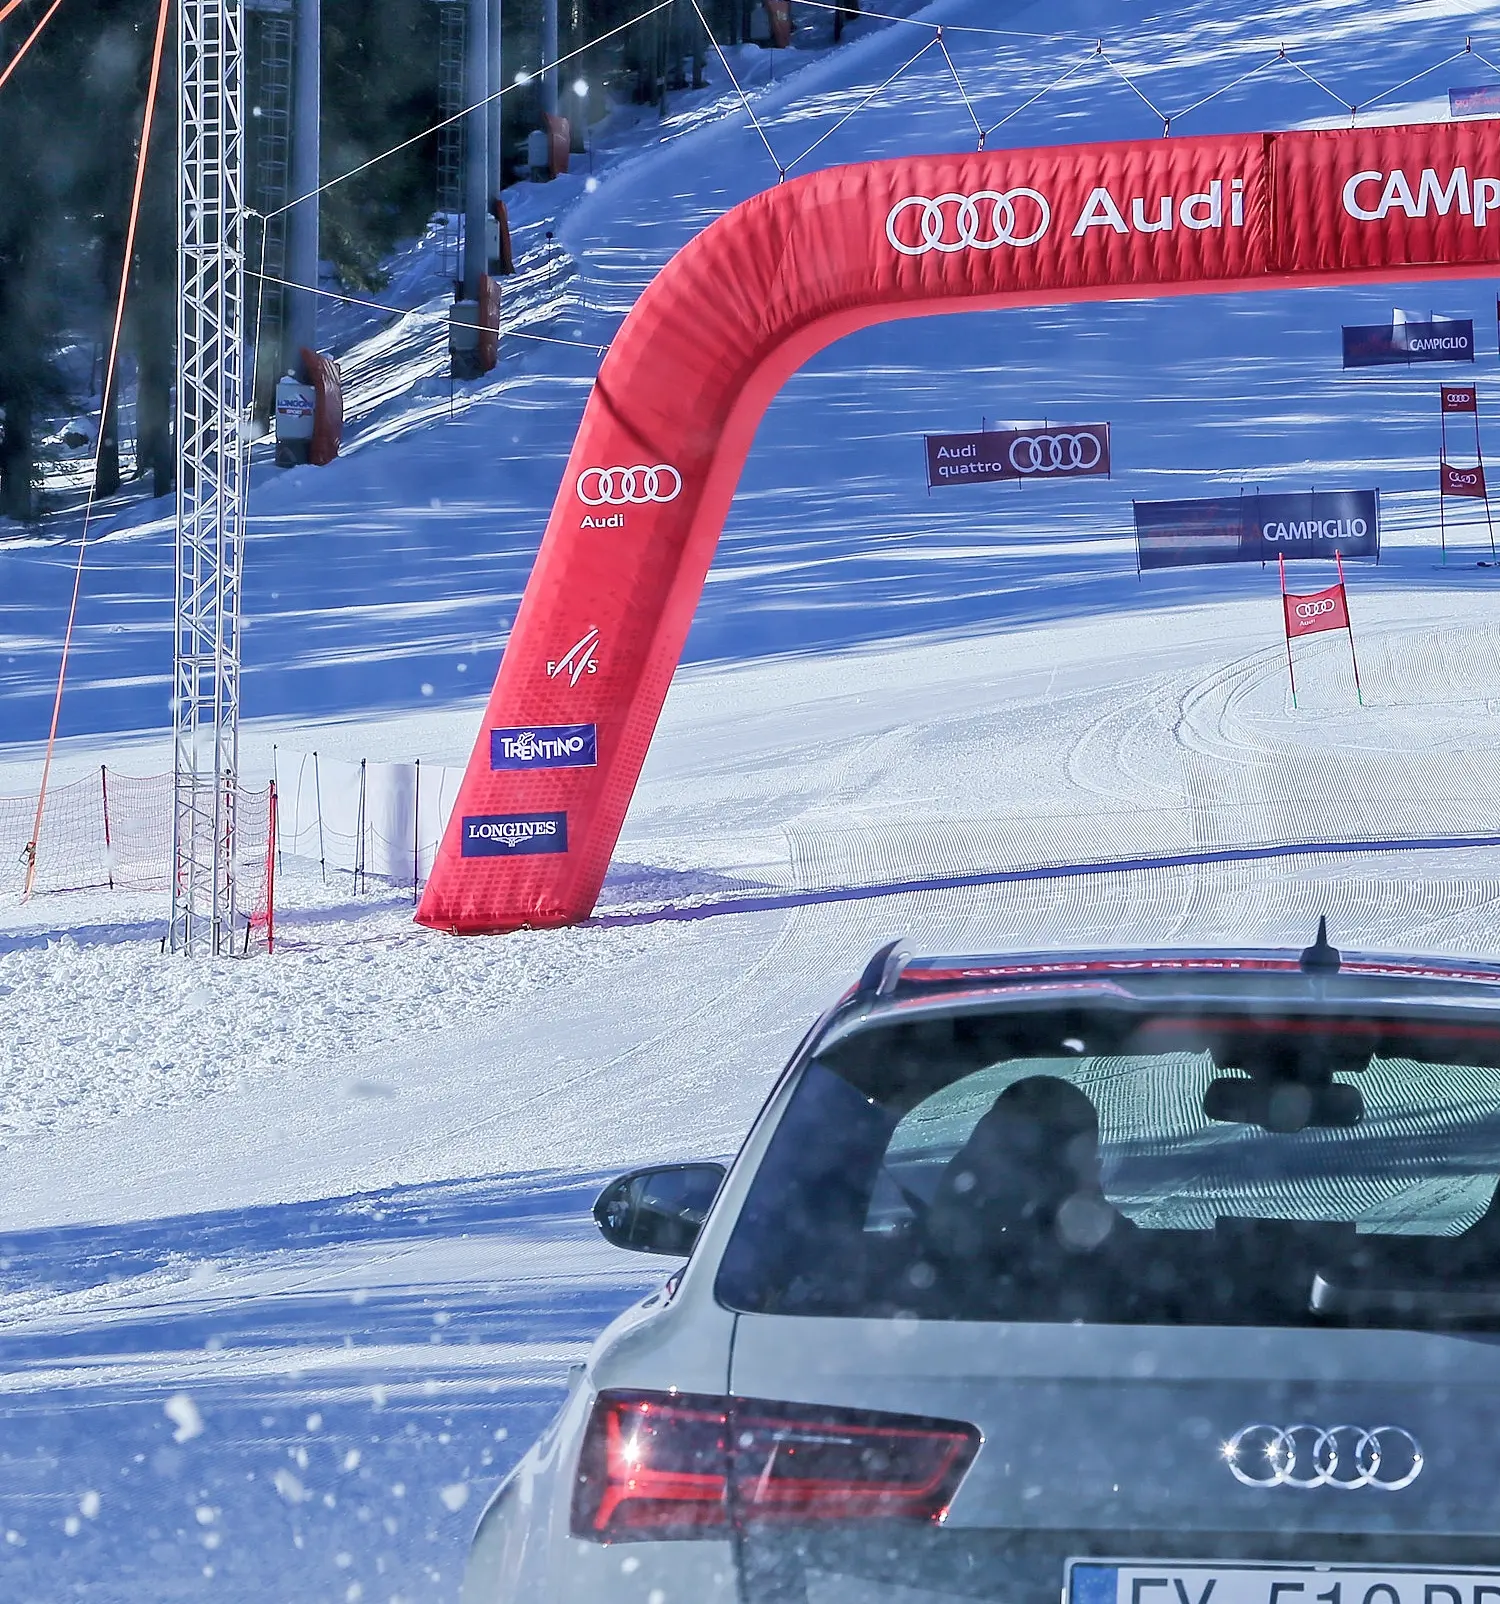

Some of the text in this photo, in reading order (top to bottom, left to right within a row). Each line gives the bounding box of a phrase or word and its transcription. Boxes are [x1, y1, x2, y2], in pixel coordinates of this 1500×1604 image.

[1071, 178, 1245, 237] Audi
[1409, 336, 1468, 351] CAMPIGLIO
[937, 444, 977, 459] Audi
[938, 460, 1002, 477] quattro
[580, 513, 625, 530] Audi
[1262, 518, 1367, 542] CAMPIGLIO
[500, 734, 583, 761] TRENTINO
[468, 820, 558, 838] LONGINES
